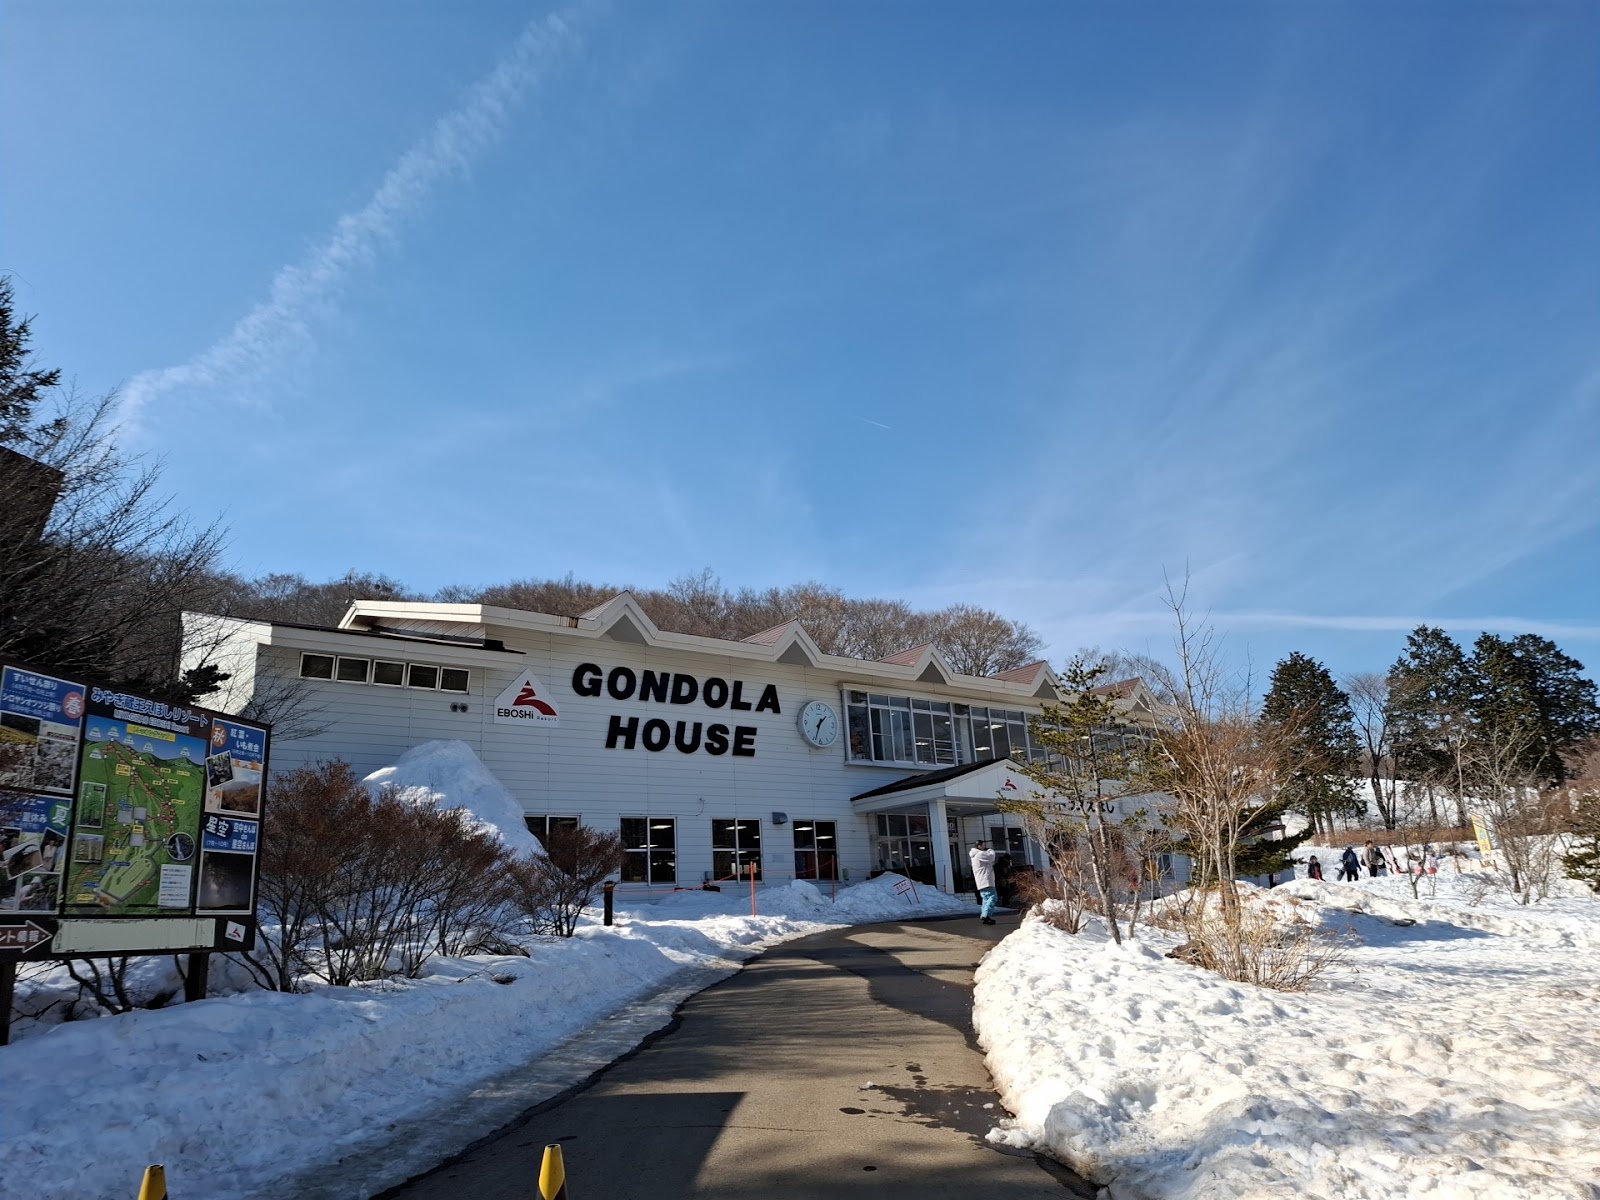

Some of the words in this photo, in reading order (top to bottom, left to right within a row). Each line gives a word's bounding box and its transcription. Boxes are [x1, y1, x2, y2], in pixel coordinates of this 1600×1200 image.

[571, 662, 781, 715] GONDOLA
[65, 696, 81, 715] 春
[212, 727, 225, 745] 秋
[605, 715, 757, 757] HOUSE
[52, 804, 71, 827] 夏
[205, 815, 230, 838] 星空
